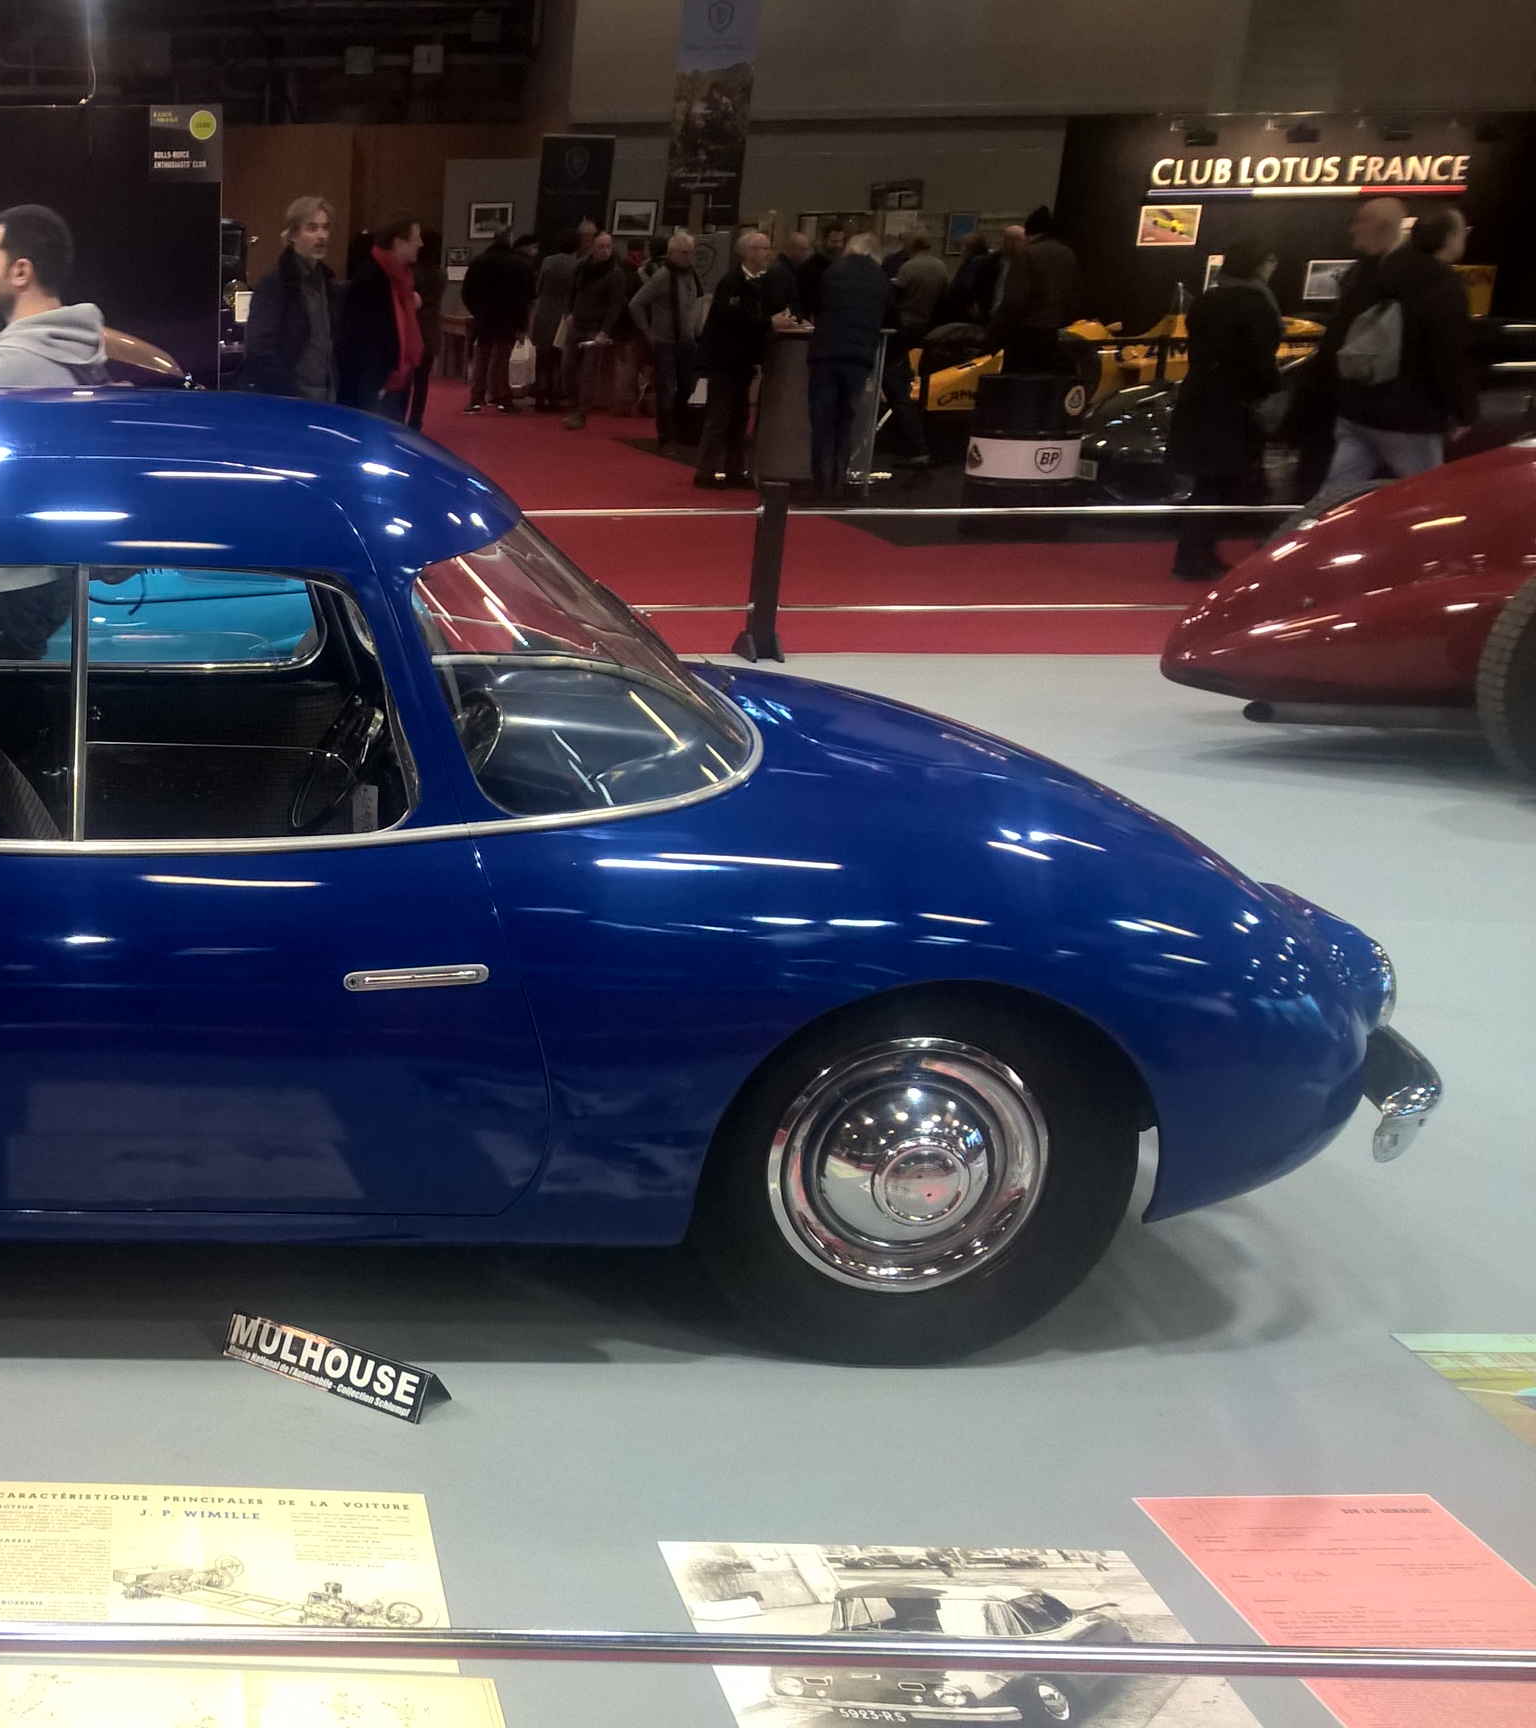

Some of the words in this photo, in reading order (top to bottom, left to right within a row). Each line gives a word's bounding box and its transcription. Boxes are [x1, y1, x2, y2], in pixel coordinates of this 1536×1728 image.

[1151, 156, 1233, 186] CLUB
[1239, 156, 1342, 185] LOTUS
[1347, 155, 1470, 183] FRANCE
[1039, 452, 1060, 466] BP
[229, 1314, 421, 1406] MULHOUSE
[250, 1351, 280, 1371] National
[279, 1363, 289, 1374] de
[288, 1364, 334, 1390] l'Automobile
[336, 1383, 374, 1405] Collection
[373, 1396, 412, 1419] Schlumpf
[139, 1509, 153, 1517] J.
[161, 1509, 175, 1518] P.
[183, 1510, 261, 1520] WIMILLE
[163, 1495, 264, 1505] PRINCIPALES
[309, 1500, 329, 1508] LA
[342, 1501, 410, 1511] VOITURE
